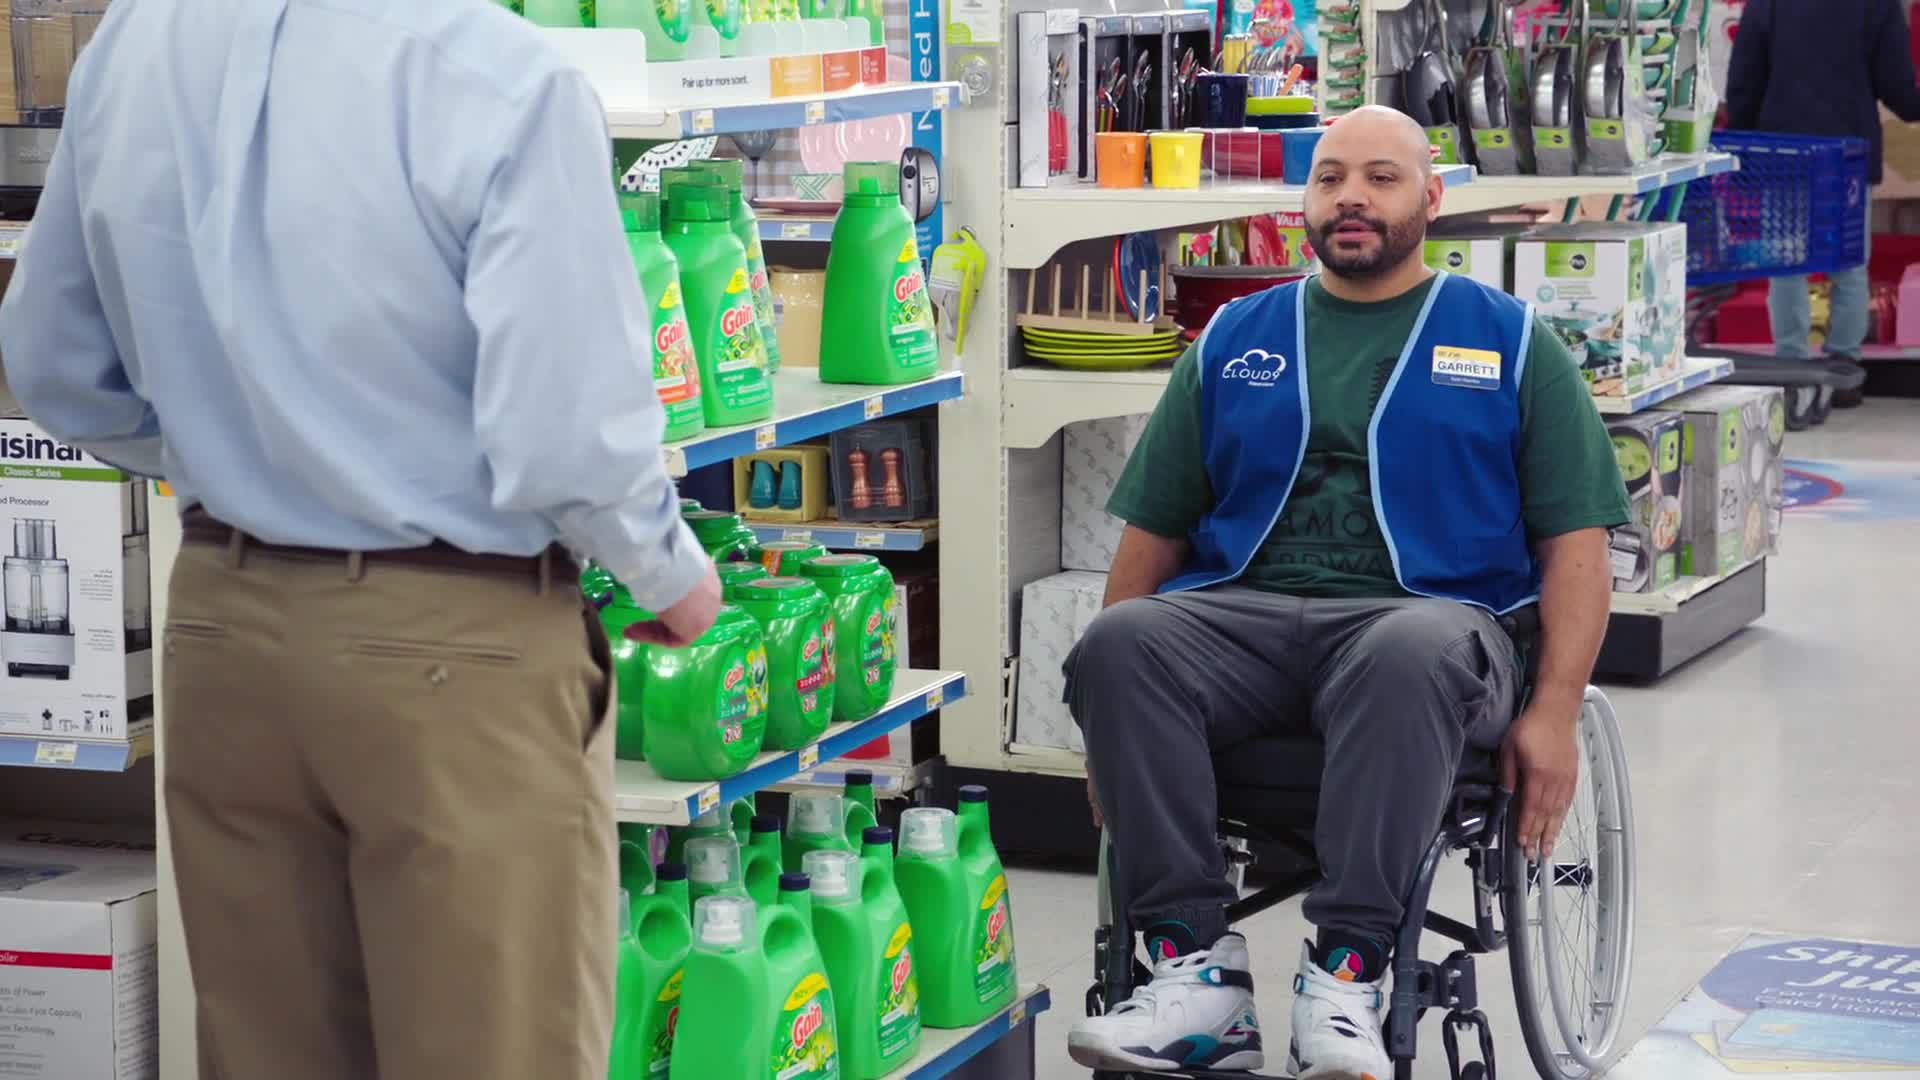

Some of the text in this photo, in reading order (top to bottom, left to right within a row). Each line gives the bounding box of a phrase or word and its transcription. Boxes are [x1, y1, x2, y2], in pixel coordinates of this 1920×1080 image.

[682, 77, 695, 88] Pair
[696, 77, 703, 88] up
[705, 76, 713, 87] for
[714, 76, 731, 86] more
[893, 272, 922, 302] Gain
[720, 304, 754, 337] Gain
[655, 320, 687, 353] Gain
[1222, 368, 1281, 380] CLOUD9
[1437, 360, 1496, 375] GARRETT
[3, 467, 62, 478] Classic Series
[9, 496, 50, 507] Processor
[724, 665, 744, 691] Gain
[987, 903, 1006, 943] Gain
[892, 951, 912, 993] Gain
[793, 1003, 822, 1048] Gain
